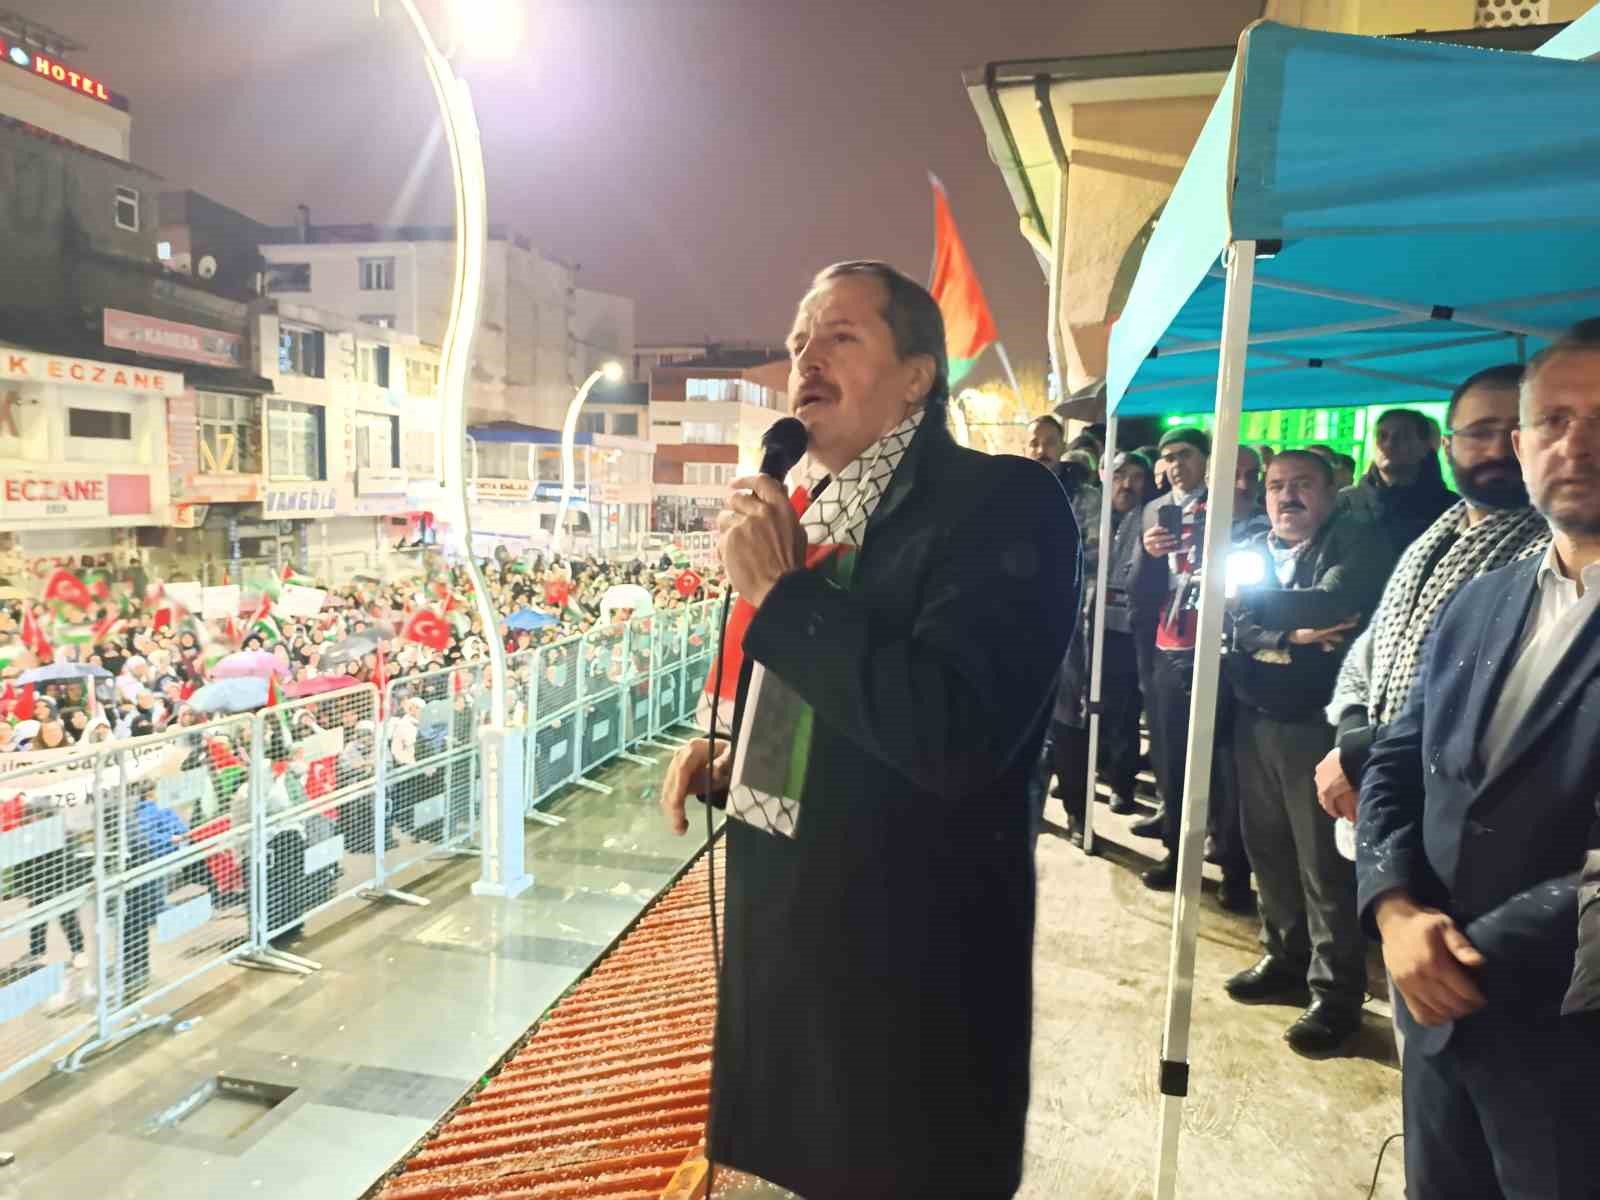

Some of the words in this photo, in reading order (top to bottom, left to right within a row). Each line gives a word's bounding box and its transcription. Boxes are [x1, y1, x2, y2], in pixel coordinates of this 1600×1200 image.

[35, 55, 109, 100] HOTEL
[47, 358, 168, 389] ECZANE
[5, 479, 104, 501] ECZANE
